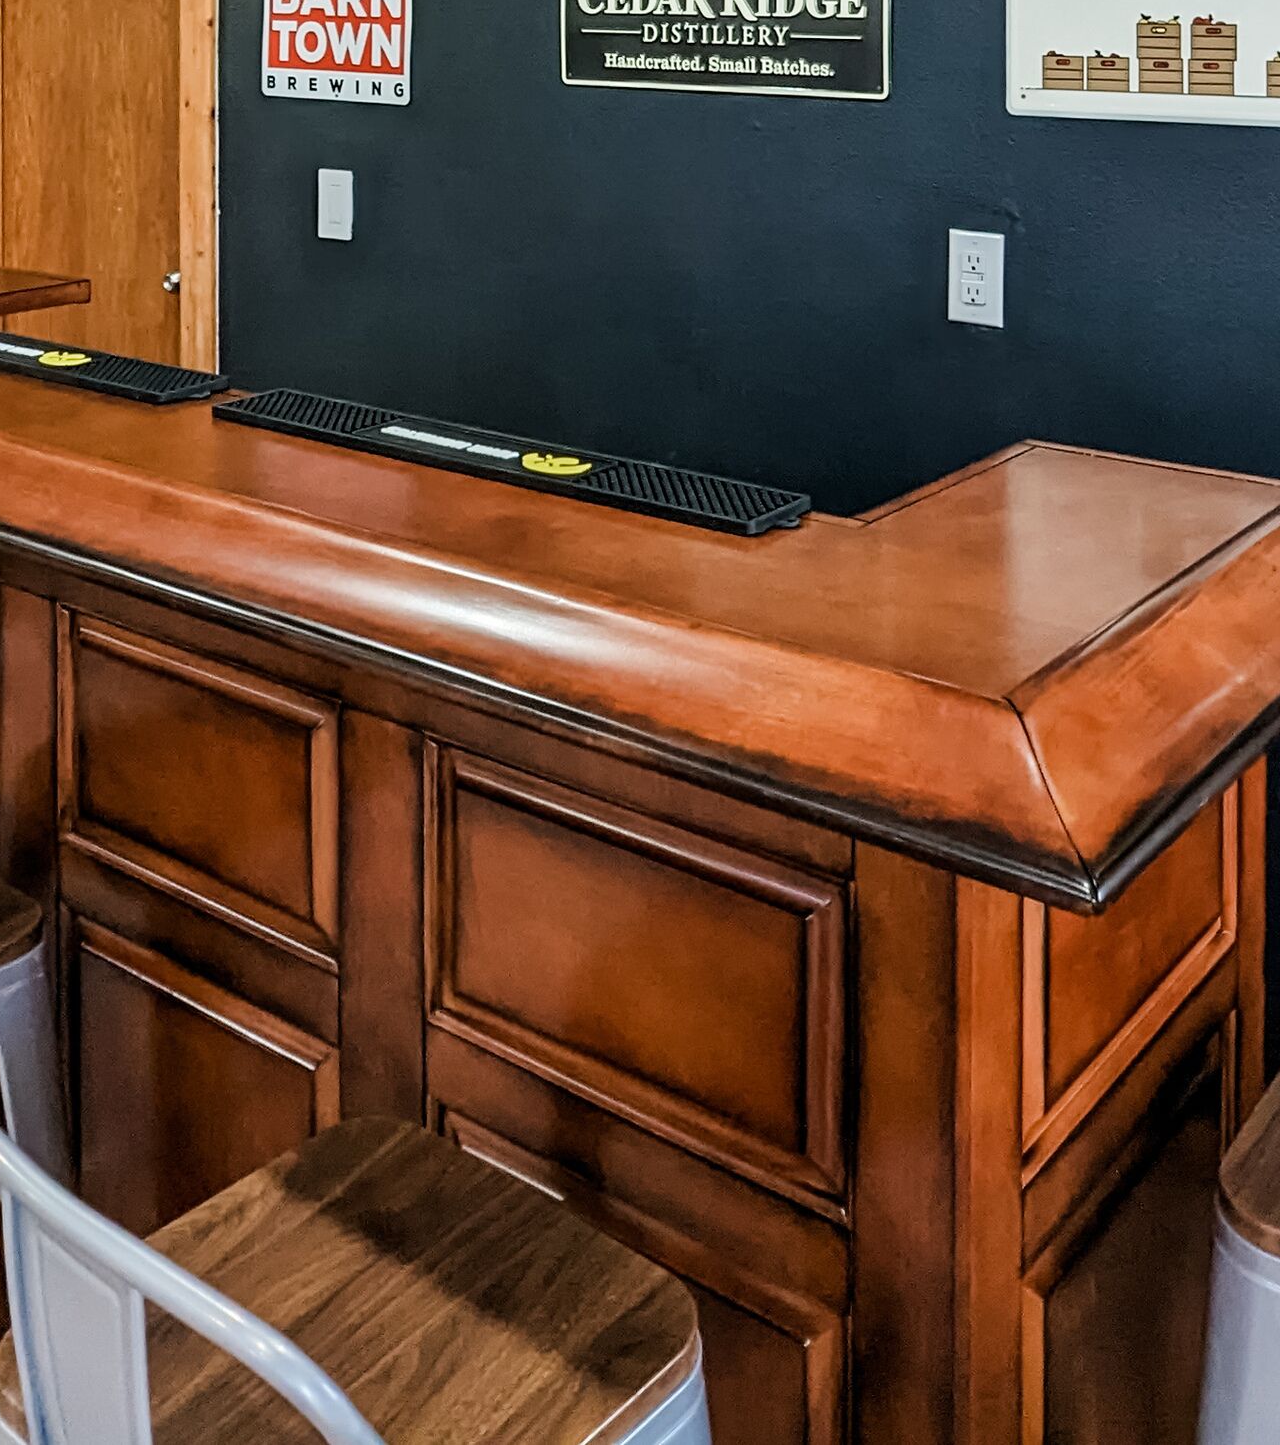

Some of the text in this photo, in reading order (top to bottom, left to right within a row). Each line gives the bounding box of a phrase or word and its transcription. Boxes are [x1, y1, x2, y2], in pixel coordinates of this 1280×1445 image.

[271, 20, 402, 68] TOWN
[642, 22, 790, 46] DISTILLERY
[604, 53, 835, 77] Handcrafted. Small Batches.
[266, 74, 405, 98] BREWING
